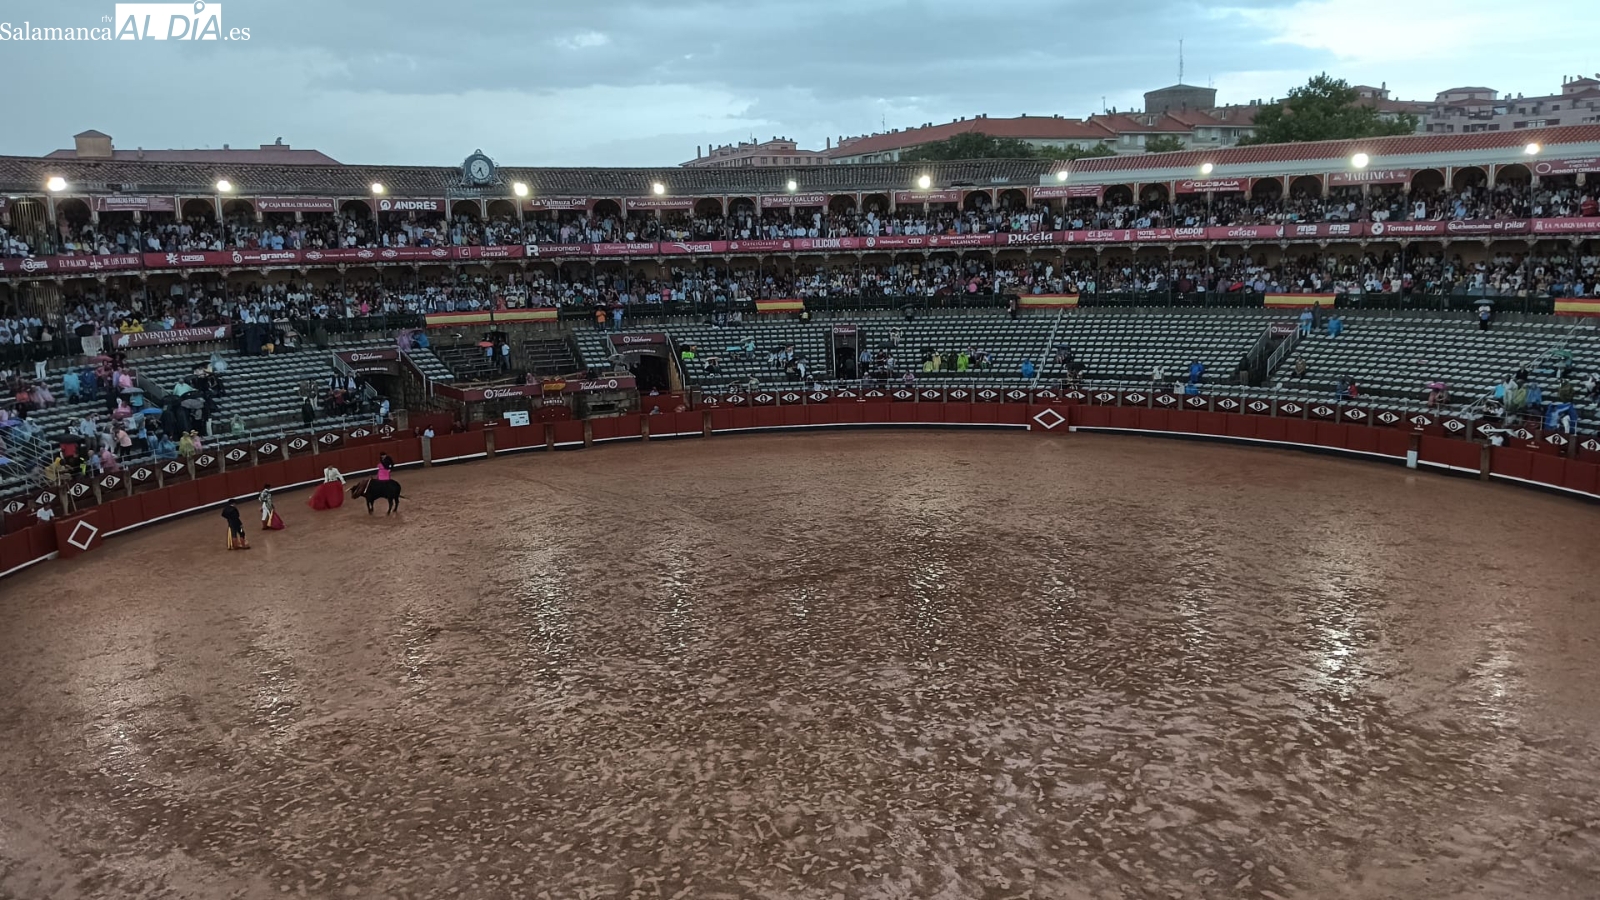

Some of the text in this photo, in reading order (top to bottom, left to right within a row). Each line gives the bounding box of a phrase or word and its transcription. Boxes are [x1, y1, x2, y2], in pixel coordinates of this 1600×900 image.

[394, 200, 437, 210] ANDRÉS
[572, 198, 586, 206] Golf
[1505, 221, 1526, 230] pilar
[1228, 229, 1257, 237] ORIGEN
[812, 239, 840, 248] LILICOOK
[260, 251, 296, 261] grande
[66, 259, 87, 268] PALACIO
[358, 352, 383, 360] Valduero
[580, 380, 609, 389] Valduero
[492, 387, 524, 397] Valduero
